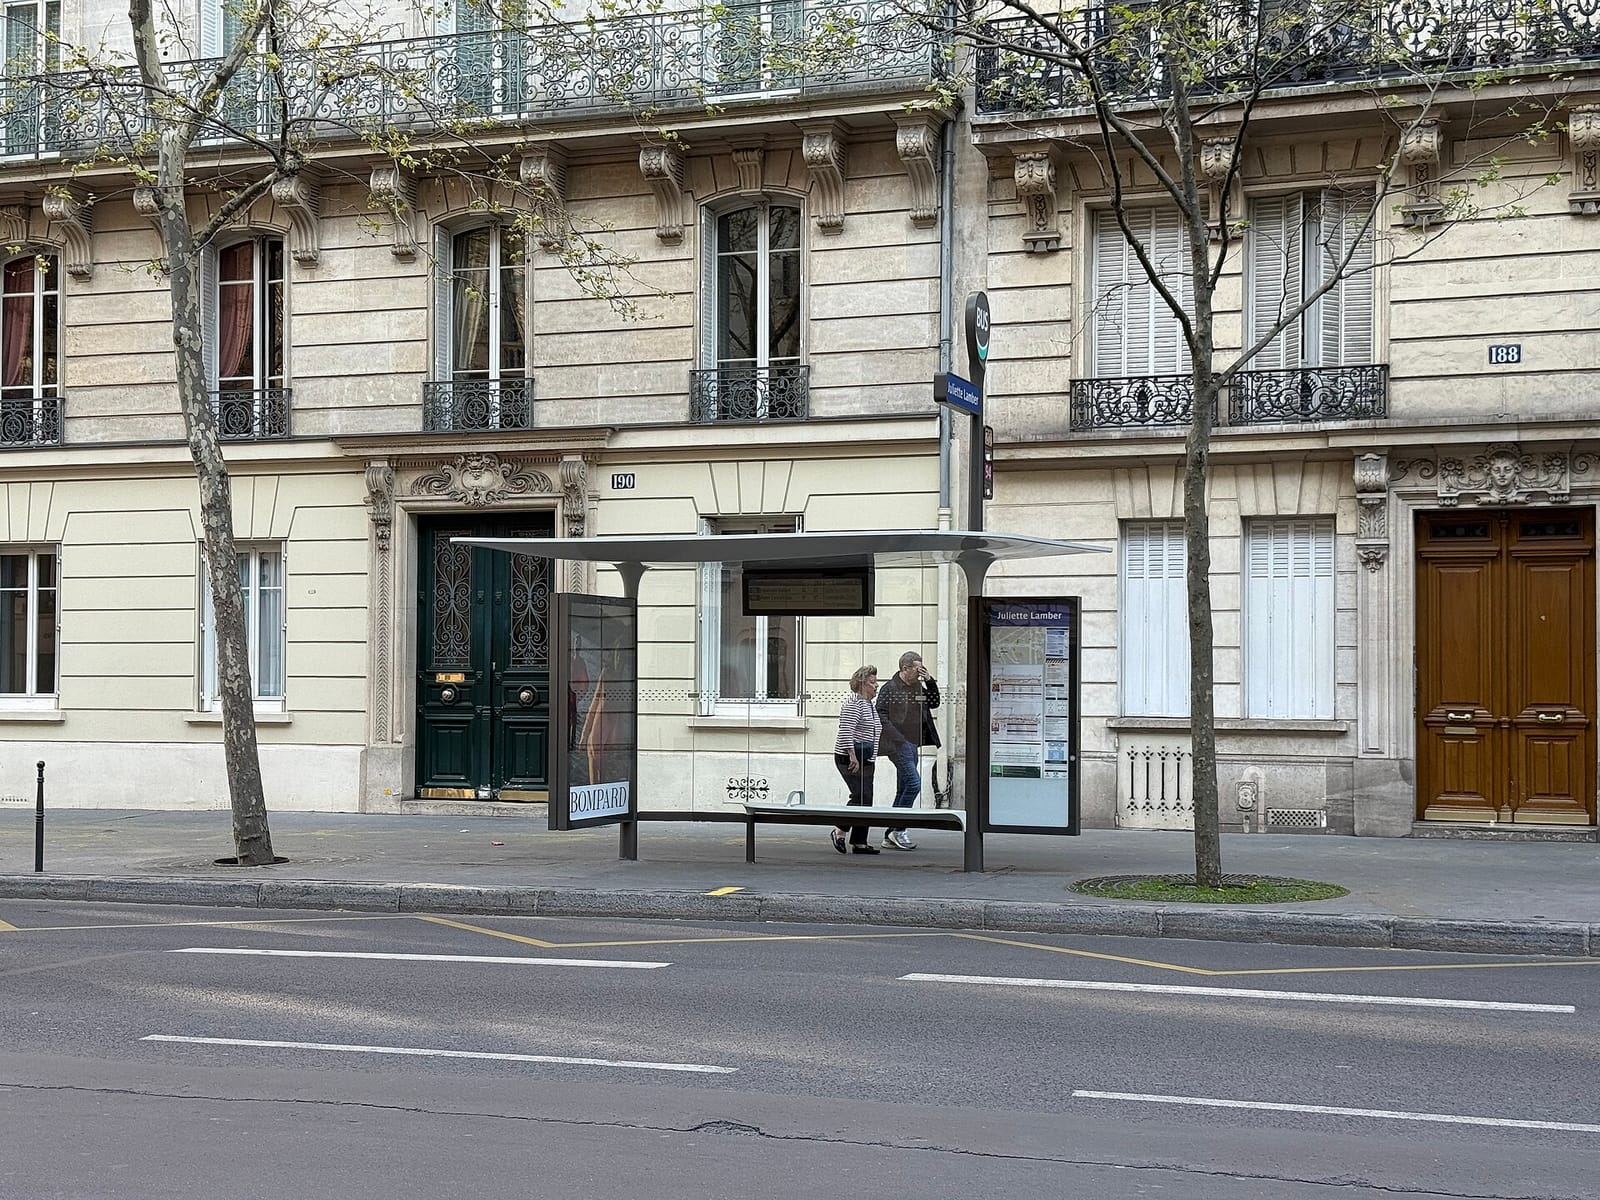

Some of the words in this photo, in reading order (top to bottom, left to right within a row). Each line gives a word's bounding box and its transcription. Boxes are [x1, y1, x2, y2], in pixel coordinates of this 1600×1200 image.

[977, 306, 988, 332] BUS
[1491, 346, 1518, 363] 188
[947, 381, 963, 400] Juliette
[963, 388, 979, 406] Lamber
[613, 474, 634, 489] 190
[997, 611, 1028, 620] Juliette
[1030, 611, 1062, 620] Lamber
[570, 786, 627, 814] BOMPARD
